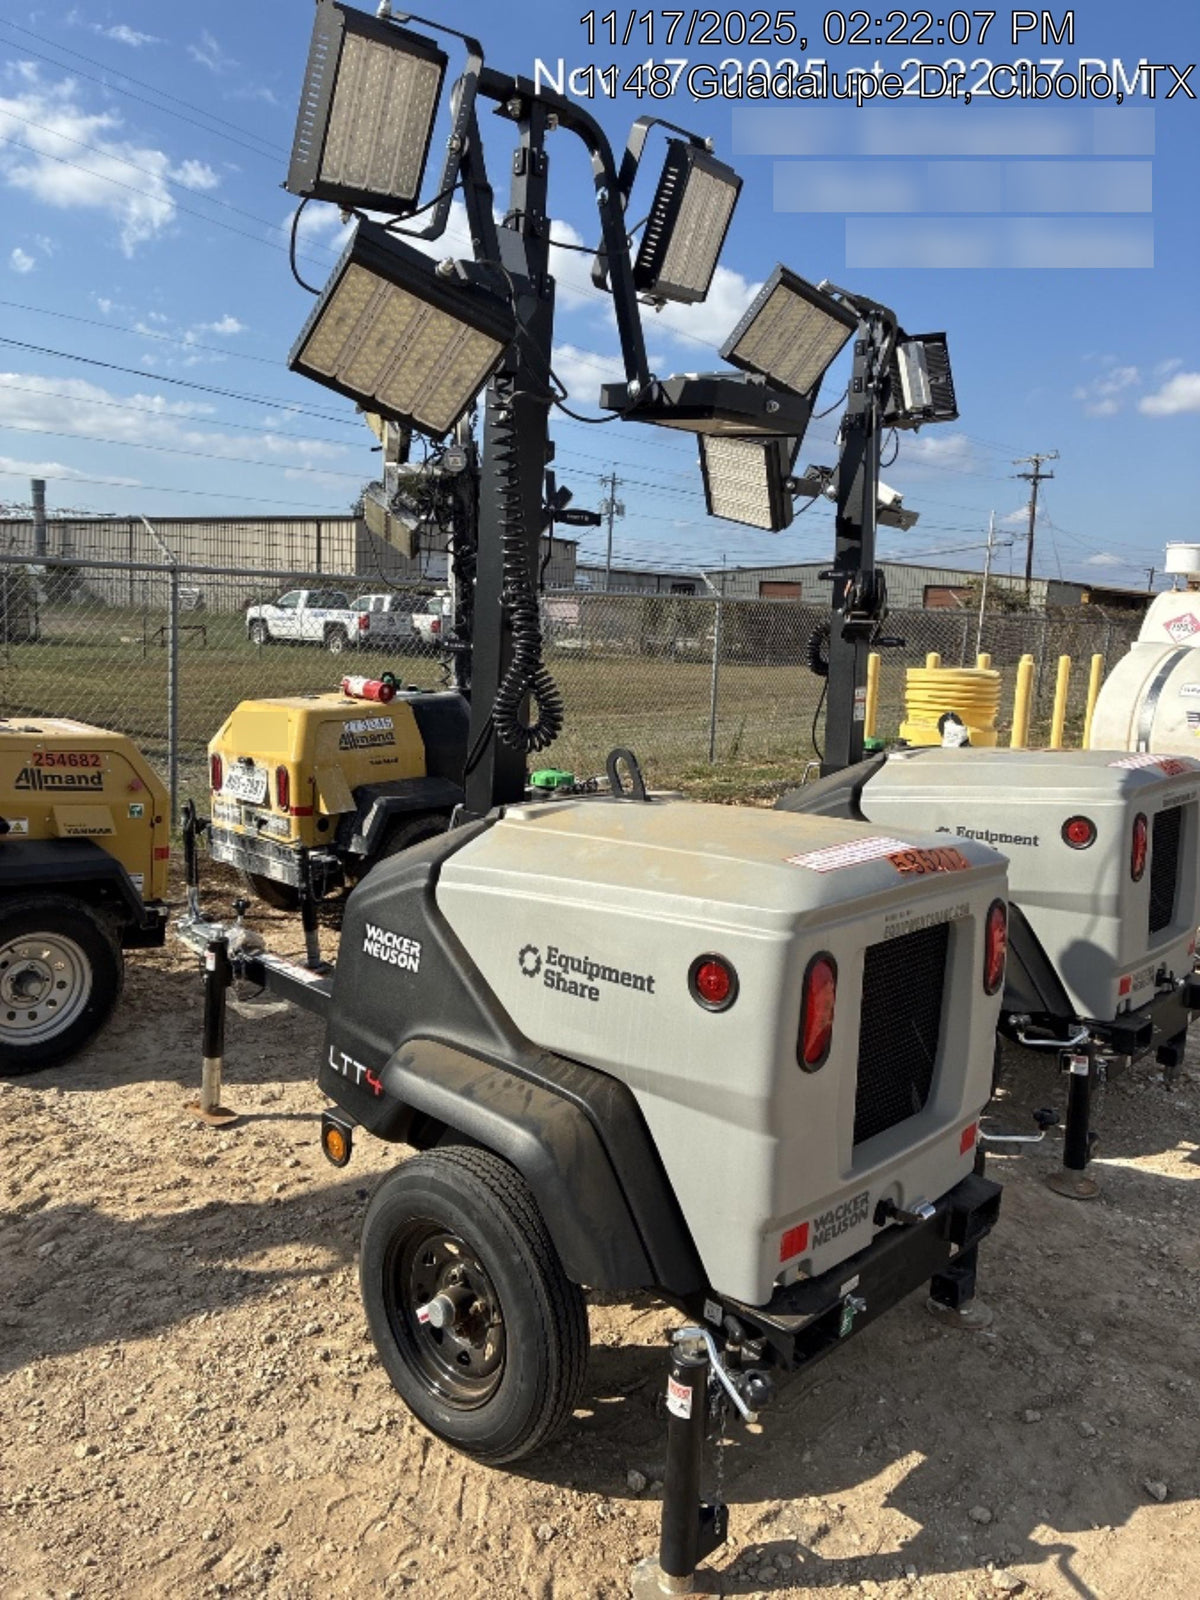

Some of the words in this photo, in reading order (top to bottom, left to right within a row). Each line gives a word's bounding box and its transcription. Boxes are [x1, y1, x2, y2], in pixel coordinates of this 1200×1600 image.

[33, 752, 101, 768] 254682
[15, 767, 104, 791] Allmand
[956, 826, 1040, 847] Equipment
[363, 938, 420, 973] NEUSON
[365, 923, 422, 957] WACKER
[543, 968, 600, 1001] Share
[545, 945, 656, 994] Equipment
[328, 1044, 383, 1096] LTT4
[813, 1190, 870, 1233] WACKER
[812, 1208, 869, 1250] NEUSON
